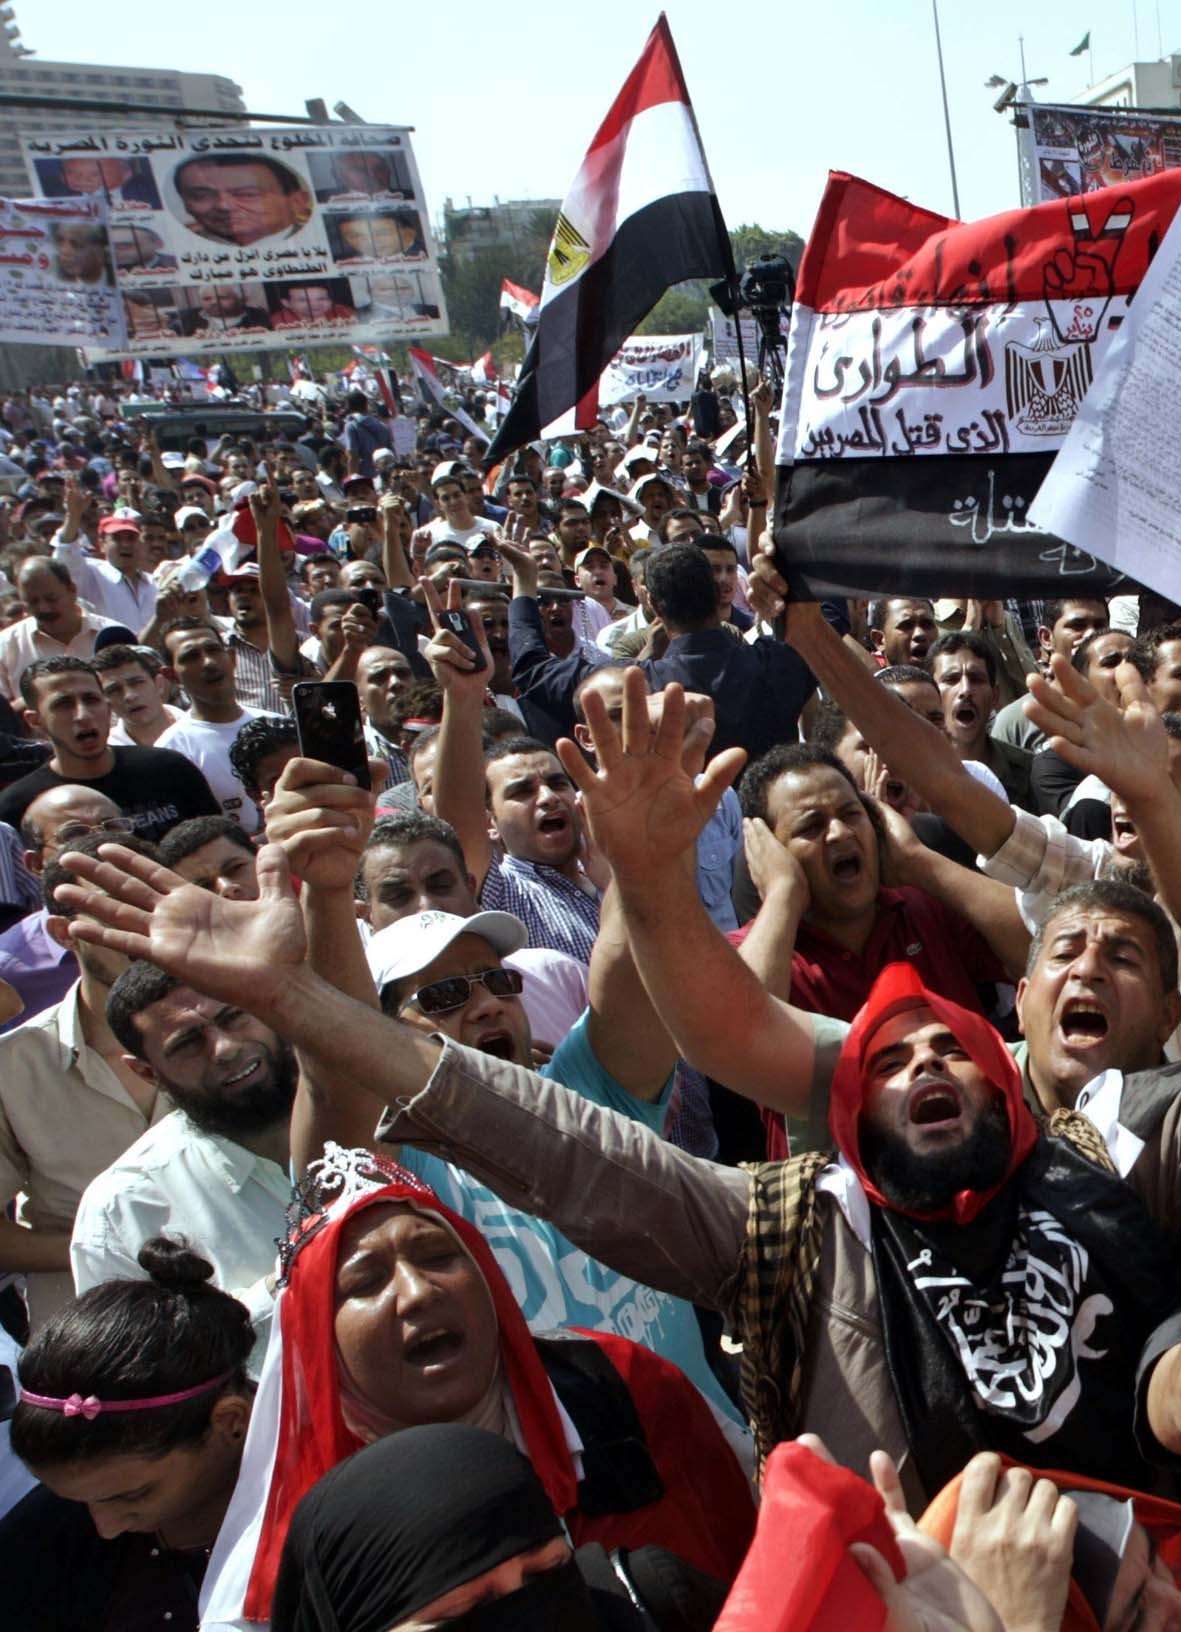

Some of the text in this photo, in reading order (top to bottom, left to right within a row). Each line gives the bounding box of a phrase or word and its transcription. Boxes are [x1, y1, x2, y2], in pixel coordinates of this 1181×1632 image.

[116, 134, 184, 155] الثورة
[1066, 315, 1094, 340] يناير
[891, 408, 944, 456] قتل
